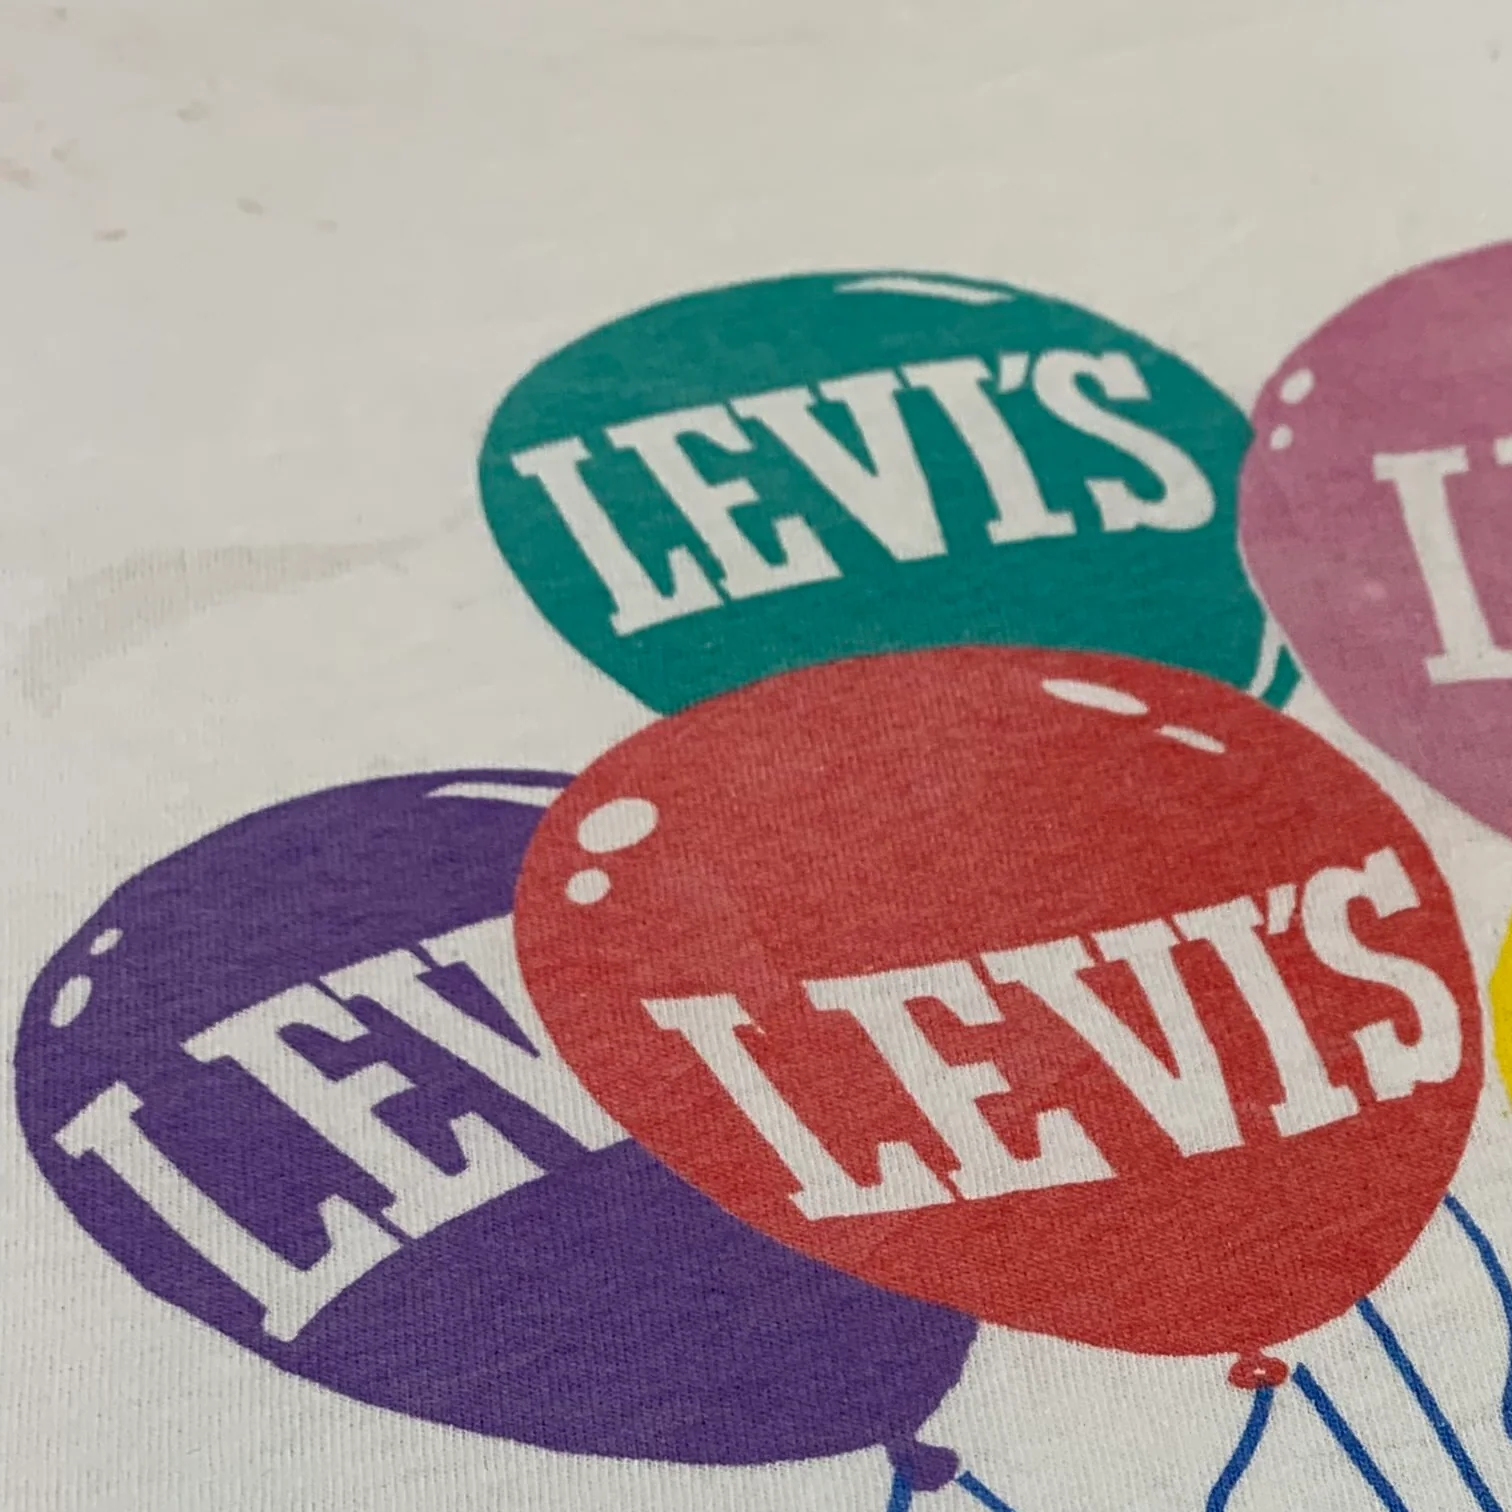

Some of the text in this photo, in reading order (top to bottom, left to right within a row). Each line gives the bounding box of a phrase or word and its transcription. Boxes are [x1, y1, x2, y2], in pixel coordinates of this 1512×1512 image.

[511, 349, 1215, 637] LEVI'S
[52, 912, 635, 1342] LEV
[641, 847, 1462, 1220] LEVI'S
